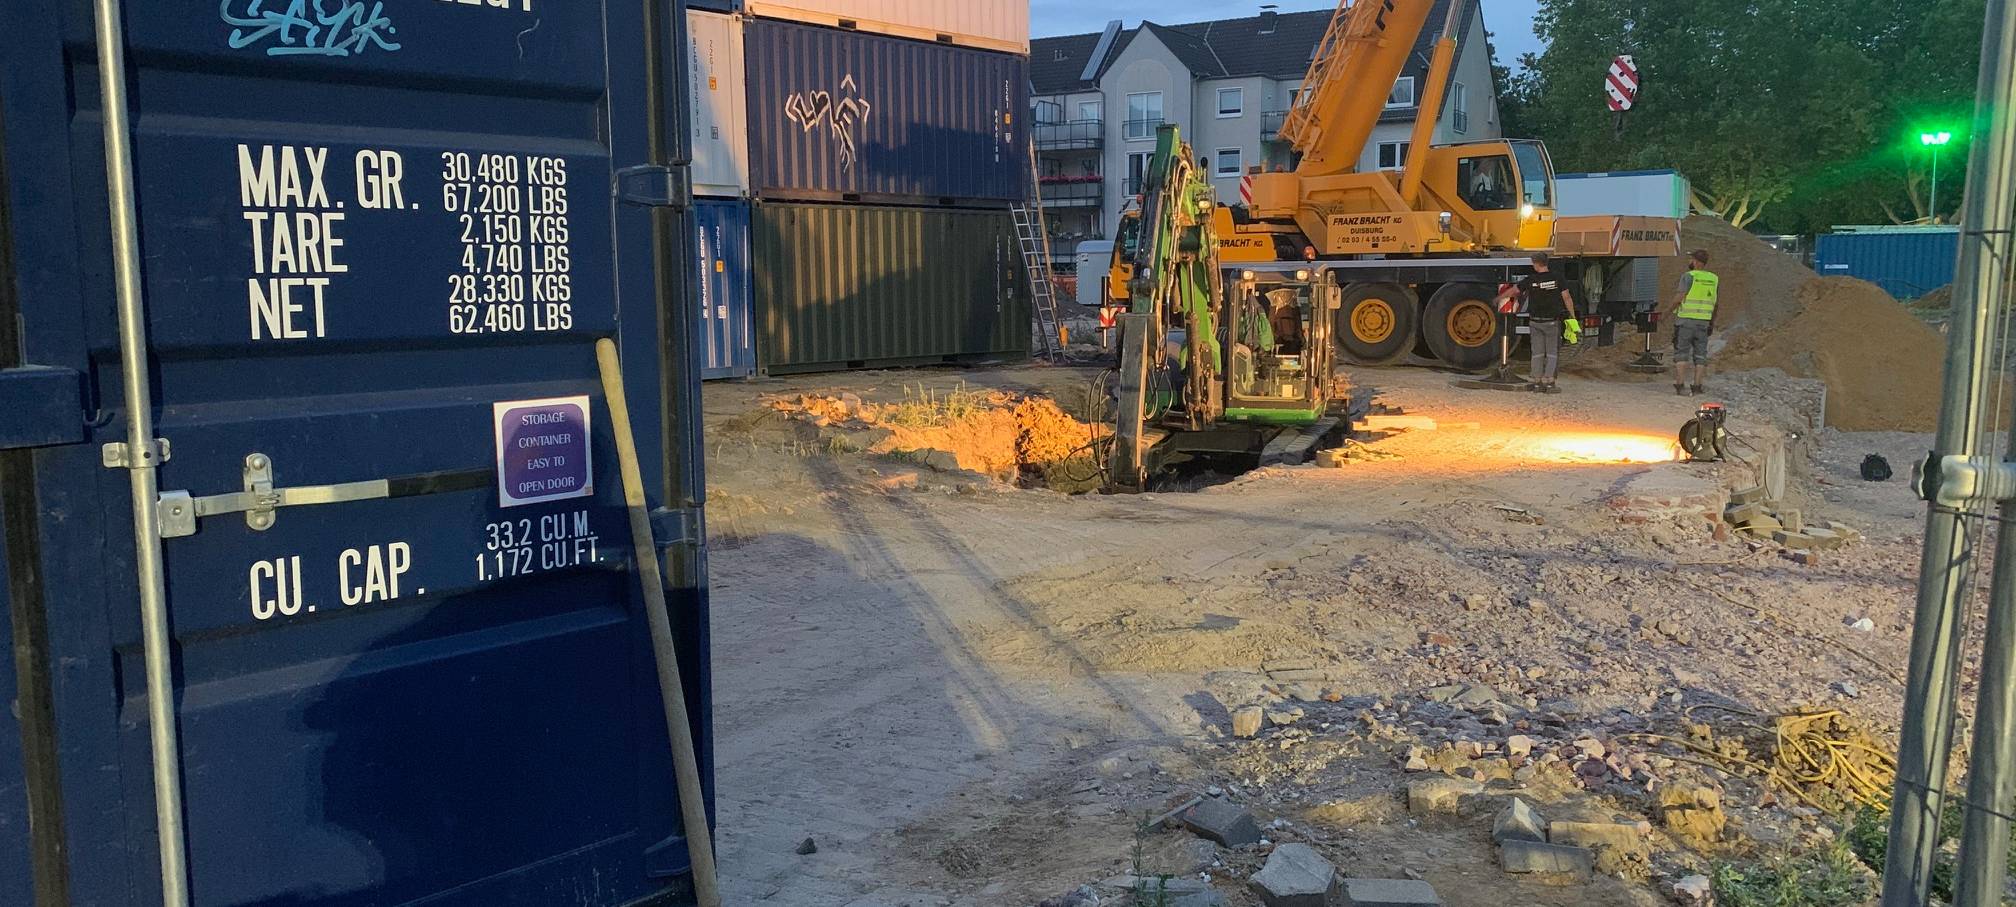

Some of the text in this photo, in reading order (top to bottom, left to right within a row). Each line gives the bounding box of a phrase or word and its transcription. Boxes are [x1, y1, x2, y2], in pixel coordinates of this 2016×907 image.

[237, 144, 419, 210] MAX. GR.
[441, 152, 567, 186] 30,480 KGS
[443, 182, 568, 215] 67,200 LBS
[460, 214, 569, 244] 2,150 KGS
[1332, 215, 1402, 226] FRANZ BRACHT KG
[1350, 227, 1384, 235] DUISBURG
[1621, 229, 1644, 241] FRANZ
[1645, 230, 1670, 242] BRACHT
[243, 211, 348, 274] TARE
[1219, 239, 1251, 248] BRACHT
[462, 244, 570, 274] 4,740 LBS
[448, 274, 571, 304] 28,330 KGS
[248, 277, 330, 340] NET
[449, 302, 573, 334] 62,460 LBS
[521, 411, 565, 426] STORAGE
[518, 433, 572, 449] CONTAINER
[527, 455, 565, 470] EASY TO
[518, 476, 575, 493] OPEN DOOR
[486, 518, 532, 551] 33.2
[475, 542, 533, 581] 1,172
[250, 540, 425, 620] CU. CAP.
